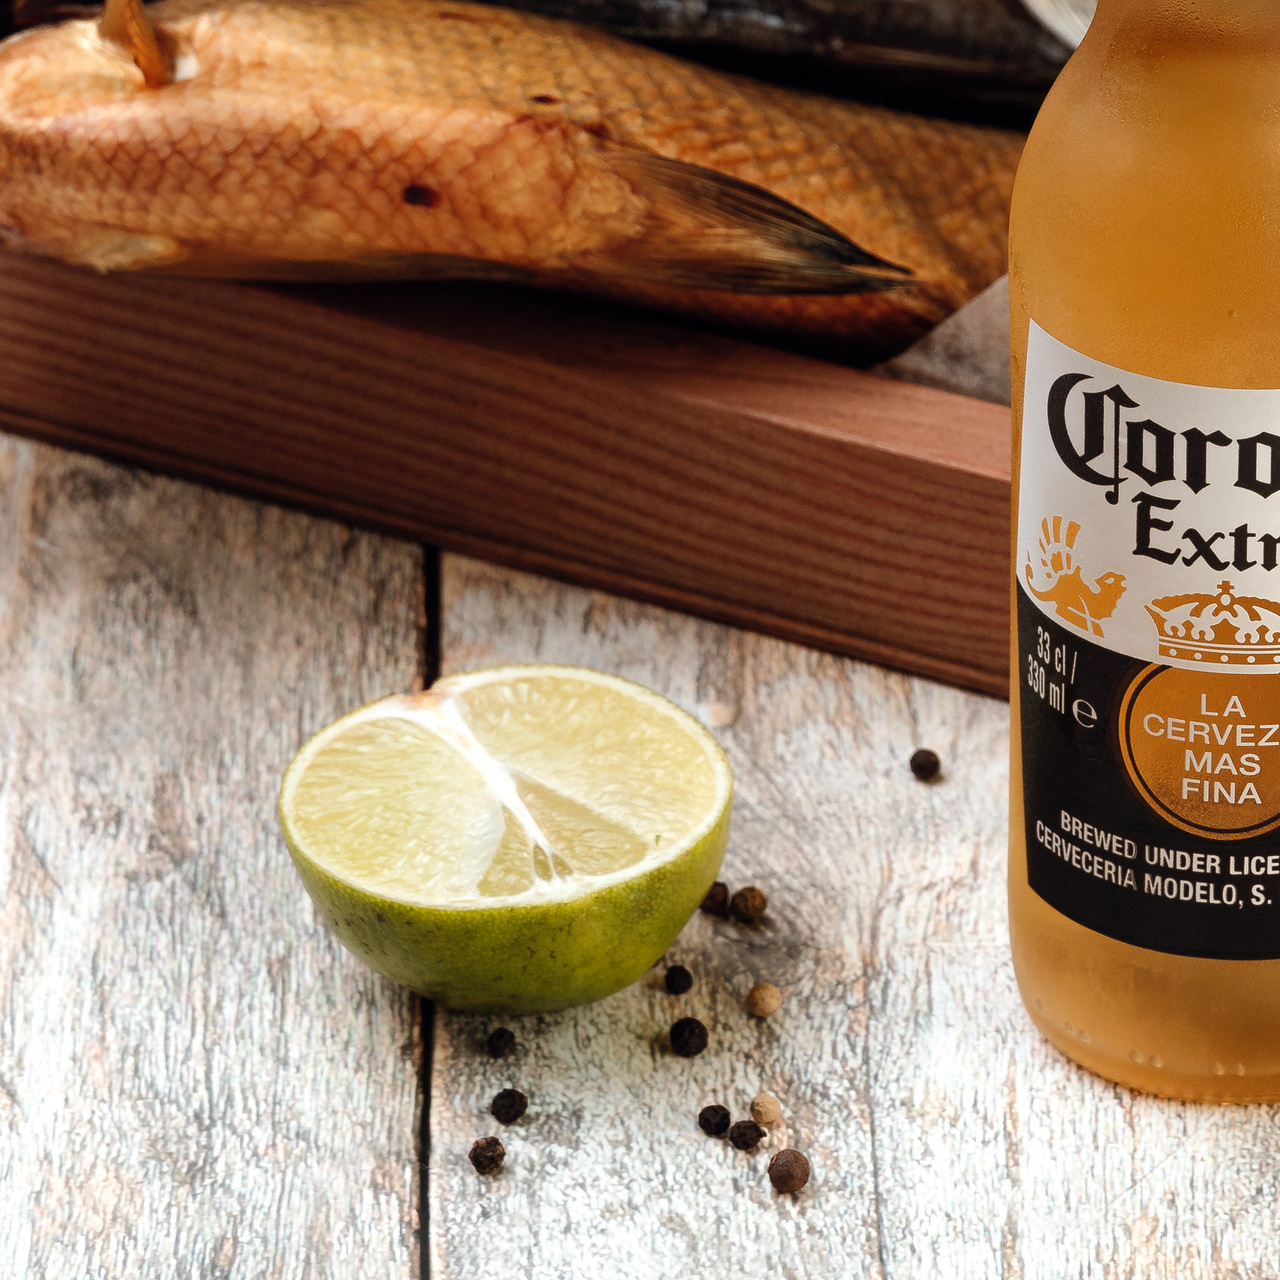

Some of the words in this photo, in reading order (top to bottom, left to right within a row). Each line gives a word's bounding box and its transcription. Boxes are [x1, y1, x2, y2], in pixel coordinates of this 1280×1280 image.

[1037, 625, 1051, 664] 33
[1054, 644, 1066, 676] cl
[1027, 654, 1046, 699] 330
[1049, 682, 1065, 715] ml
[1200, 693, 1246, 718] LA
[1184, 749, 1261, 776] MAS
[1181, 778, 1262, 805] FINA
[1036, 819, 1138, 890] CERVECERIA
[1144, 873, 1244, 908] MODELO,
[1251, 882, 1272, 906] S.
[1060, 809, 1138, 859] BREWED
[1144, 845, 1221, 875] UNDER
